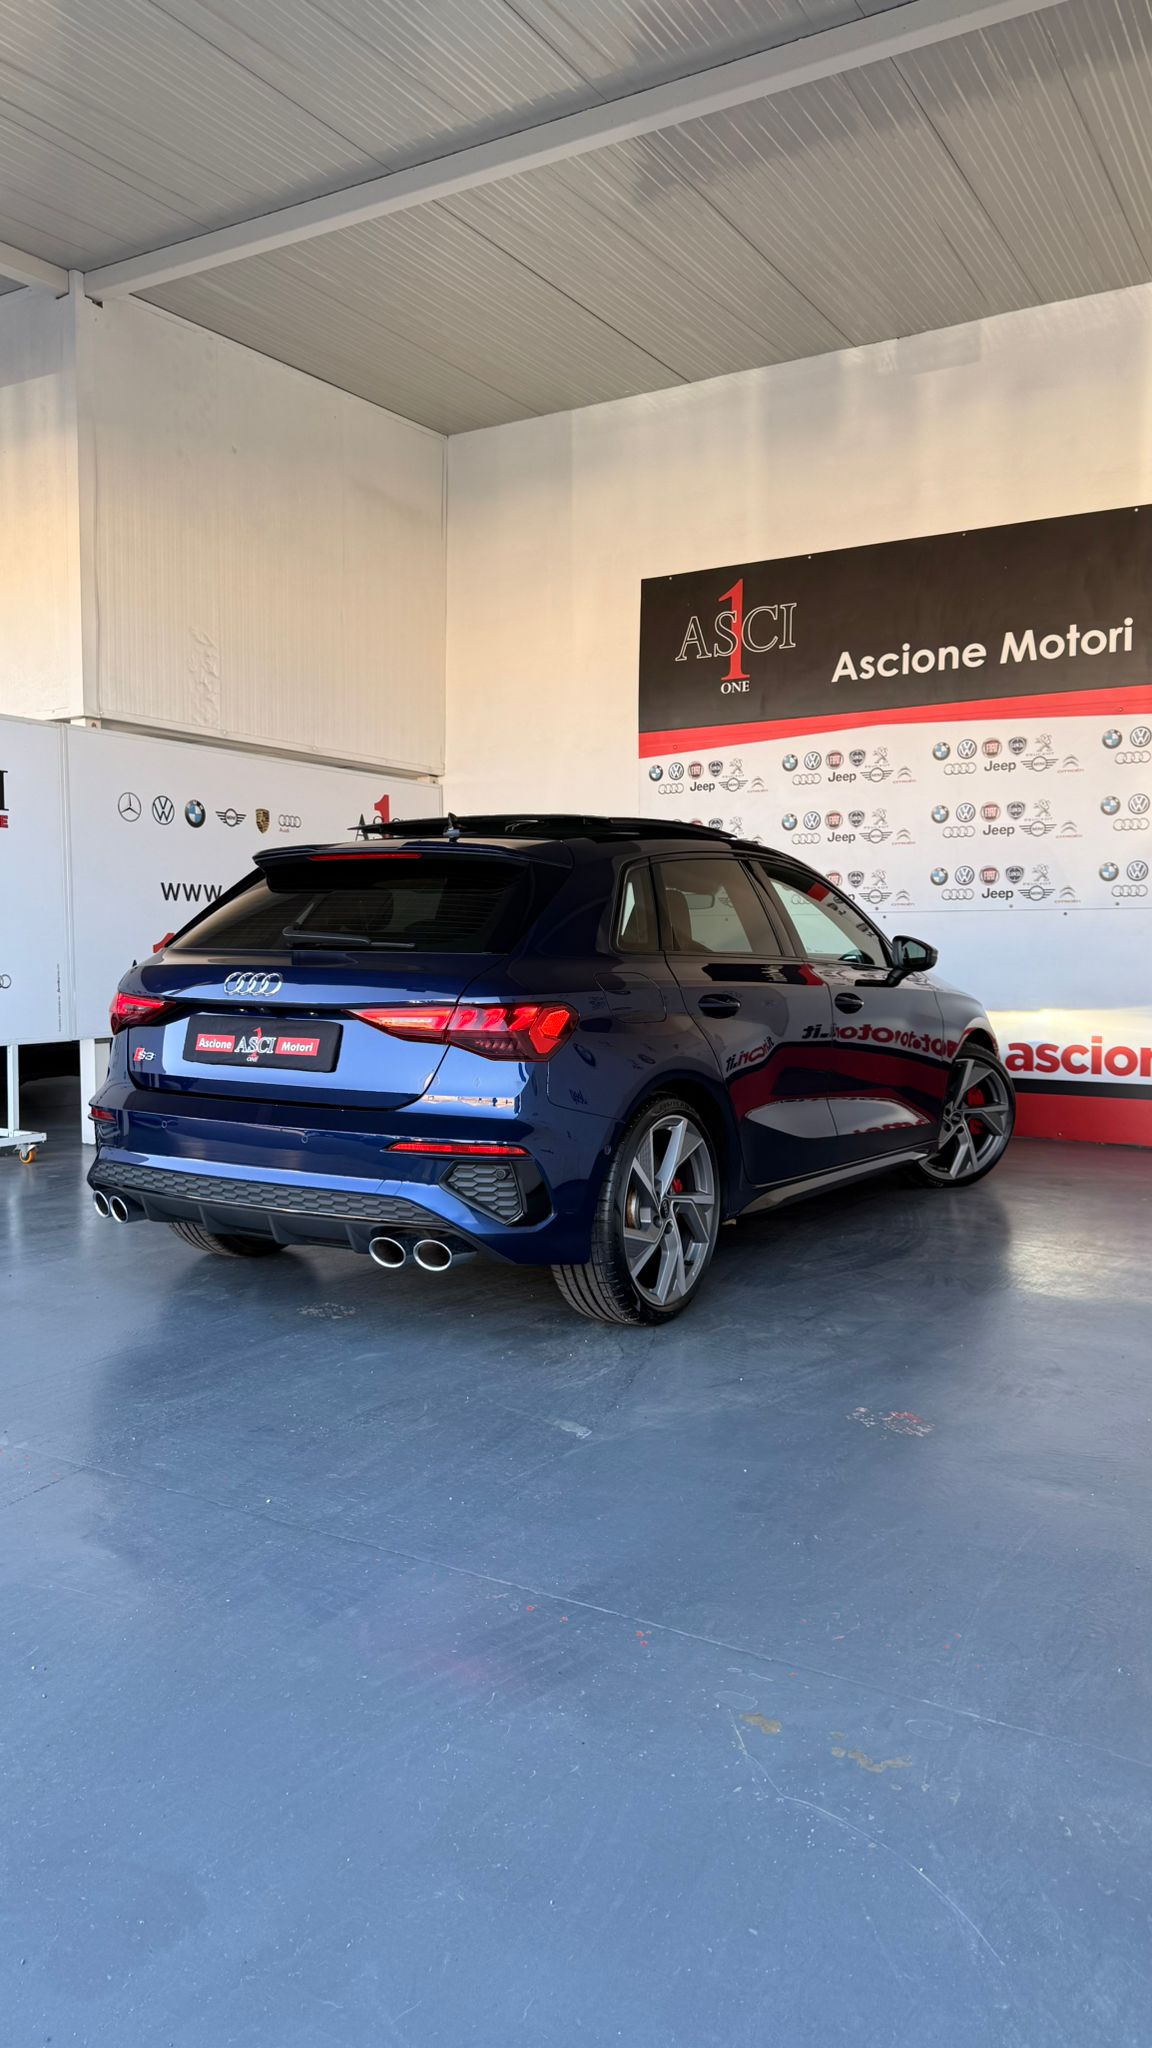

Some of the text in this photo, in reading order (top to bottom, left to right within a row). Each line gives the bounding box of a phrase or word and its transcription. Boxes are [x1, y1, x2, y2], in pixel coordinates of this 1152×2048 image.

[675, 602, 798, 662] ASCI
[831, 617, 1134, 683] Ascione Motori
[720, 680, 751, 694] ONE
[984, 760, 1017, 773] Jeep
[827, 771, 857, 783] Jeep
[690, 782, 715, 793] Jeep
[982, 824, 1015, 837] Jeep
[827, 832, 857, 844] Jeep
[981, 887, 1014, 900] Jeep
[199, 1036, 314, 1054] Ascione ASCI Motori
[136, 1048, 156, 1061] S3
